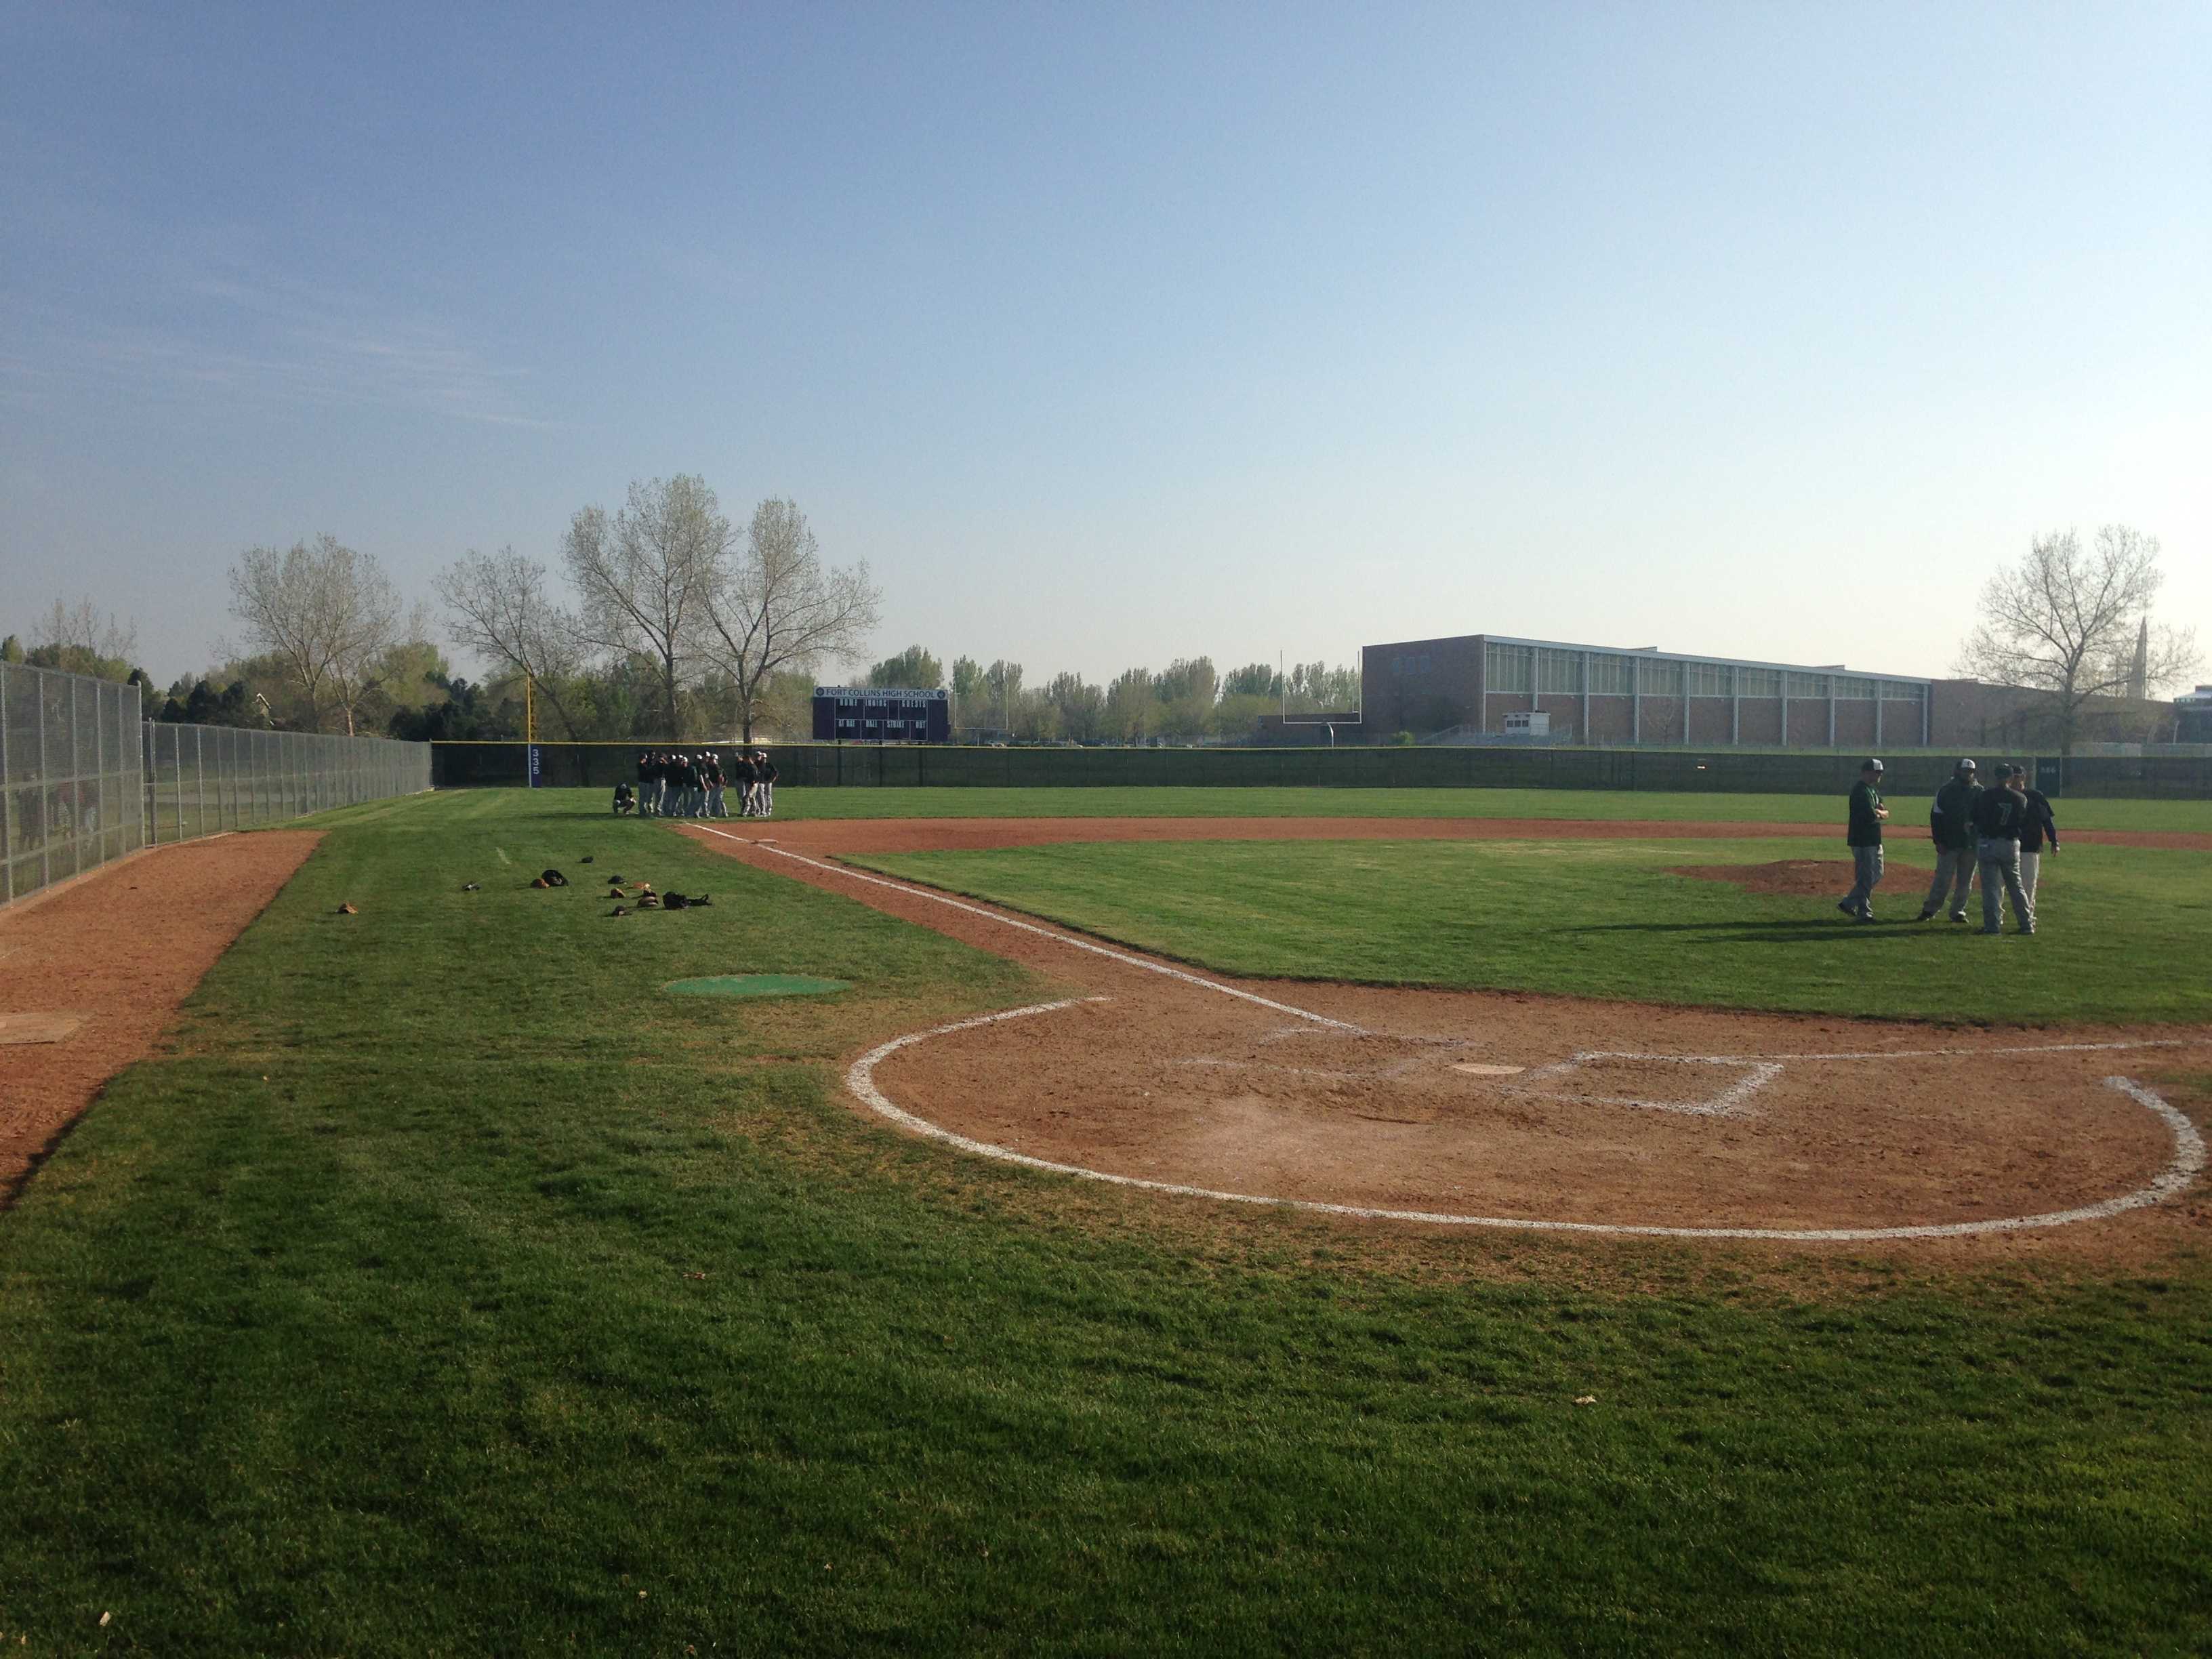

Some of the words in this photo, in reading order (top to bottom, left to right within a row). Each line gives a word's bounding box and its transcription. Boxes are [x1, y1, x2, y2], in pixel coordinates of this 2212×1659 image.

[902, 699, 926, 708] GUESTS
[532, 749, 540, 775] 335
[1997, 802, 2012, 825] 7
